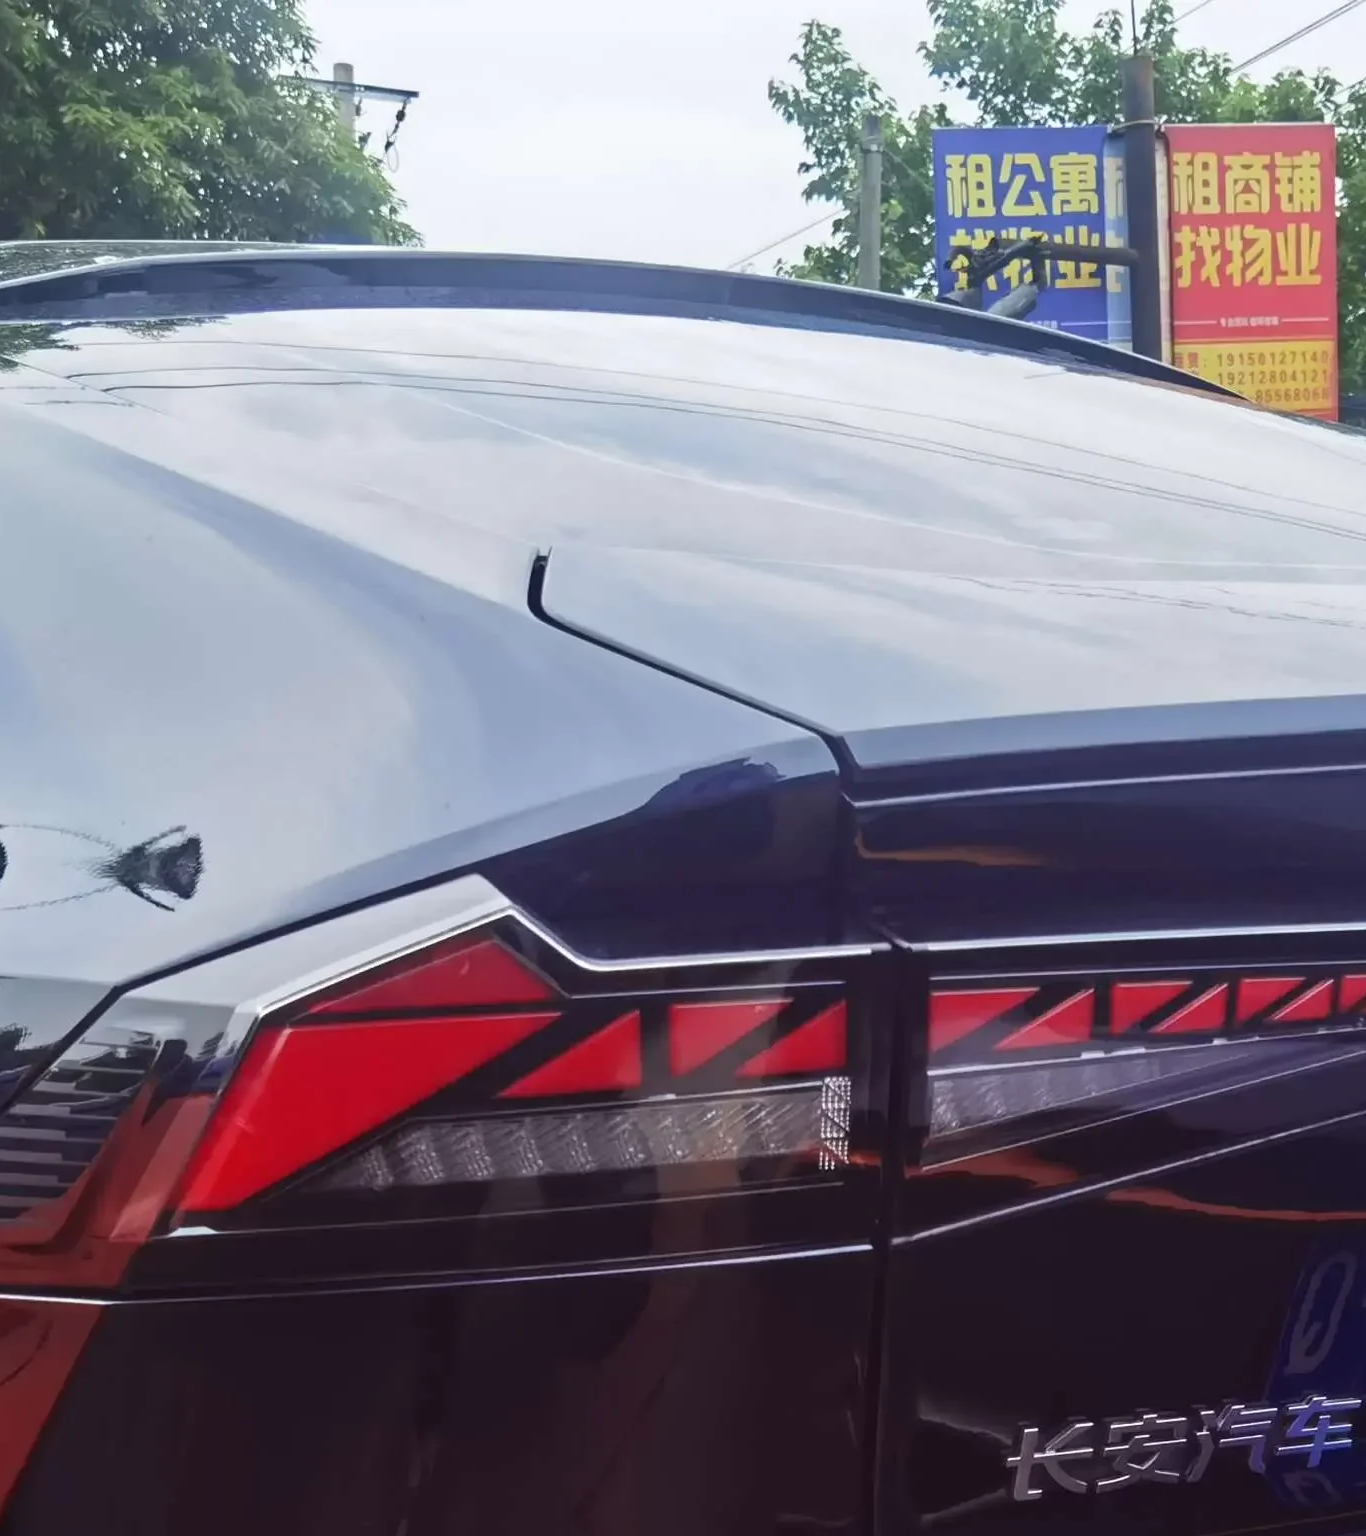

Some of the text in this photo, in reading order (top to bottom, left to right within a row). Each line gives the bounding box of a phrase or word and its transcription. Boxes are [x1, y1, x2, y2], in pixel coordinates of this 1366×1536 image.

[945, 152, 1099, 218] 租公寓
[1173, 151, 1321, 214] 租商铺
[1174, 223, 1322, 288] 找物业
[1005, 1394, 1363, 1501] 长安汽车
